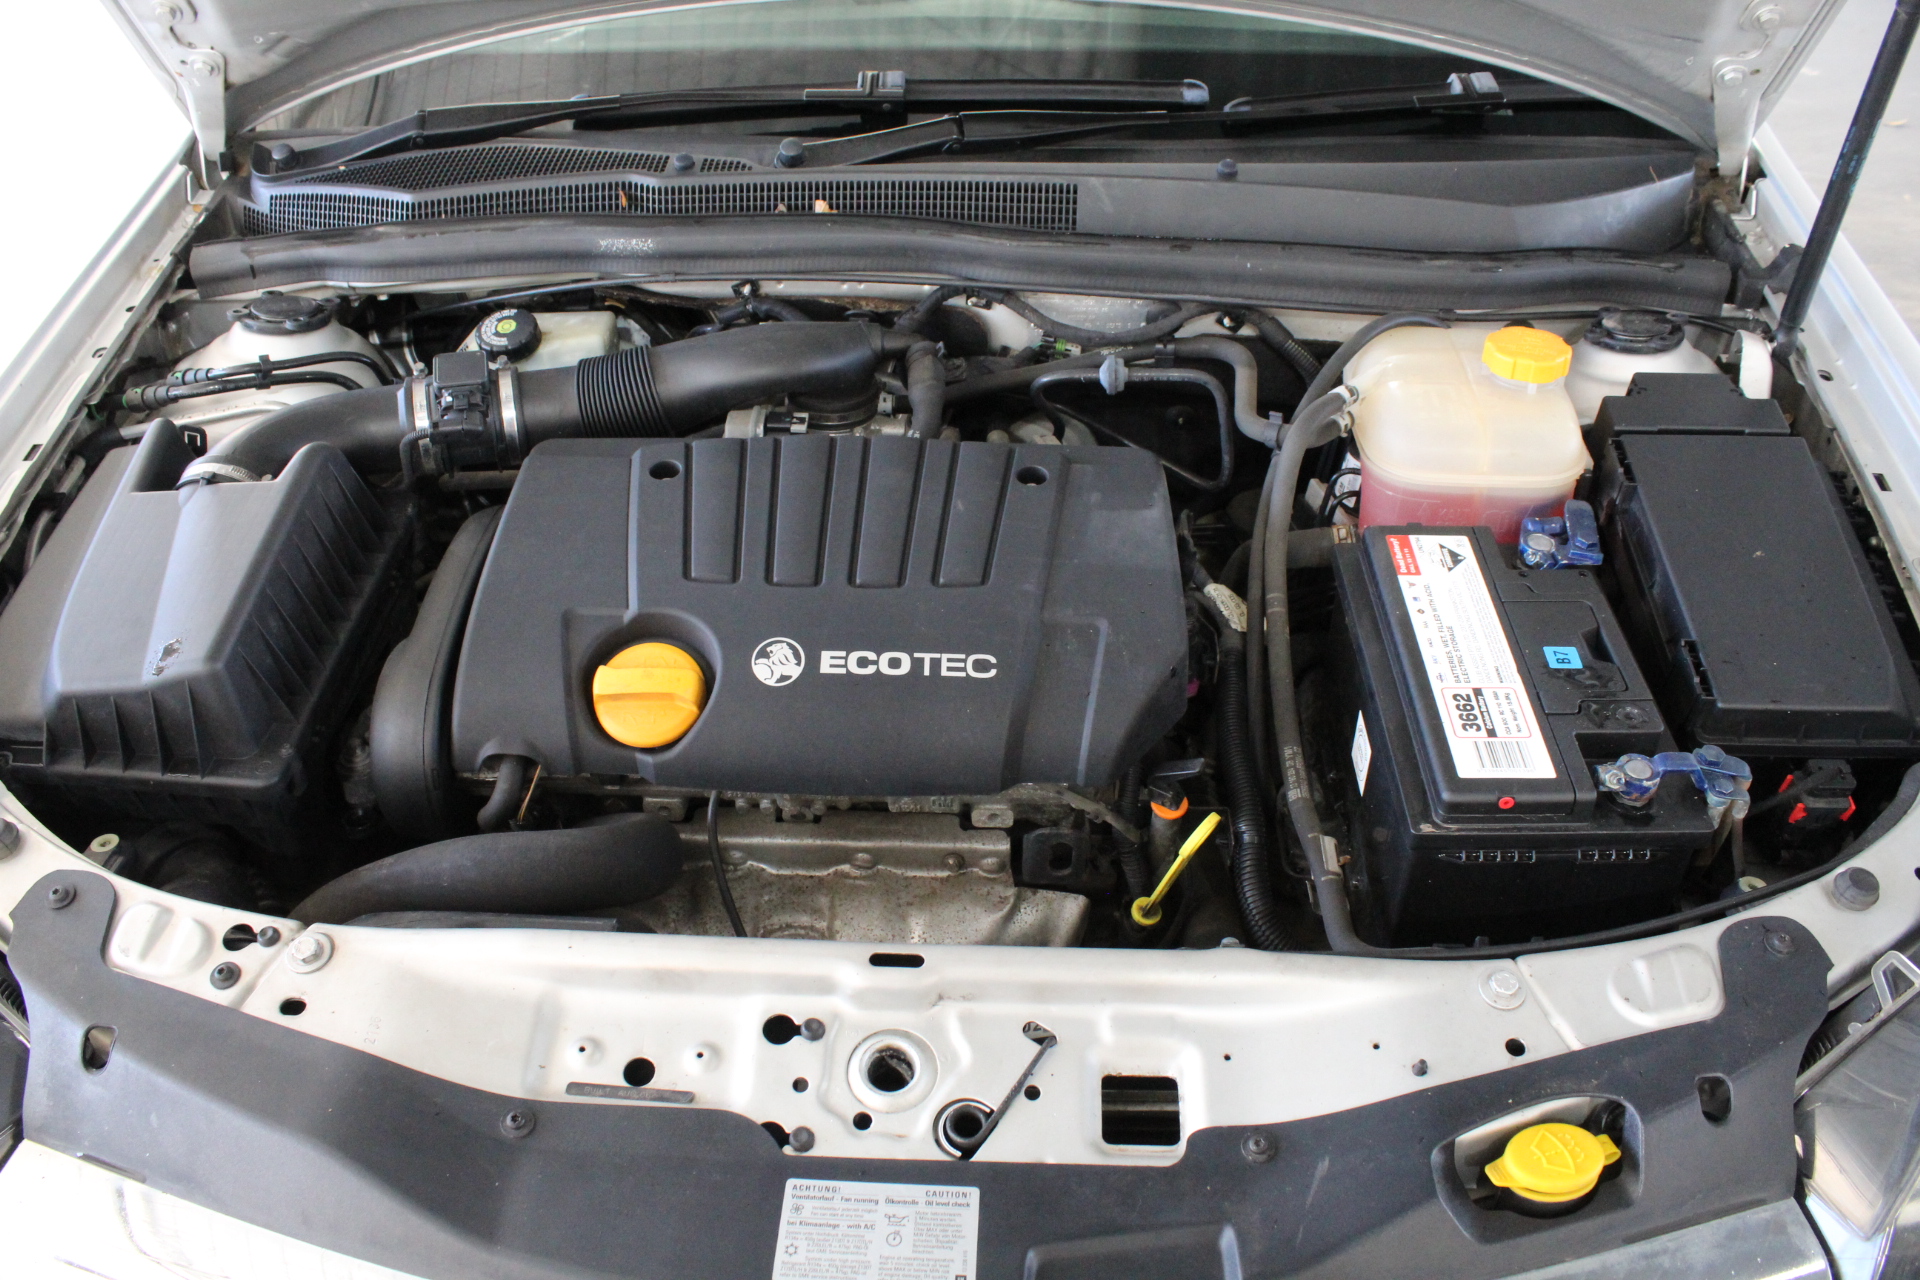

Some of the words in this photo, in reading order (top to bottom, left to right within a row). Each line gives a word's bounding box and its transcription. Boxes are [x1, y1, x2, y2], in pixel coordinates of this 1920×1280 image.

[1390, 538, 1403, 559] Battery?
[1399, 560, 1407, 572] Dead
[1428, 599, 1437, 612] WITH
[1433, 613, 1445, 633] FILLED
[1440, 635, 1450, 648] WET,
[1446, 626, 1460, 653] STORAGE
[819, 650, 998, 679] ECOTEC
[1553, 651, 1571, 664] B7
[1445, 650, 1462, 683] BATTERIES,
[1455, 654, 1471, 683] ELECTRIC
[1477, 695, 1489, 710] Battery
[1452, 693, 1482, 732] 3662
[1483, 711, 1494, 728] Calcium
[792, 1184, 841, 1193] ACHTUNG!
[925, 1190, 972, 1199] CAUTION!
[791, 1193, 835, 1202] Ventilatorlauf
[853, 1197, 880, 1205] running
[884, 1196, 919, 1206] Ölkontrolle
[799, 1220, 841, 1230] Klimaanlage
